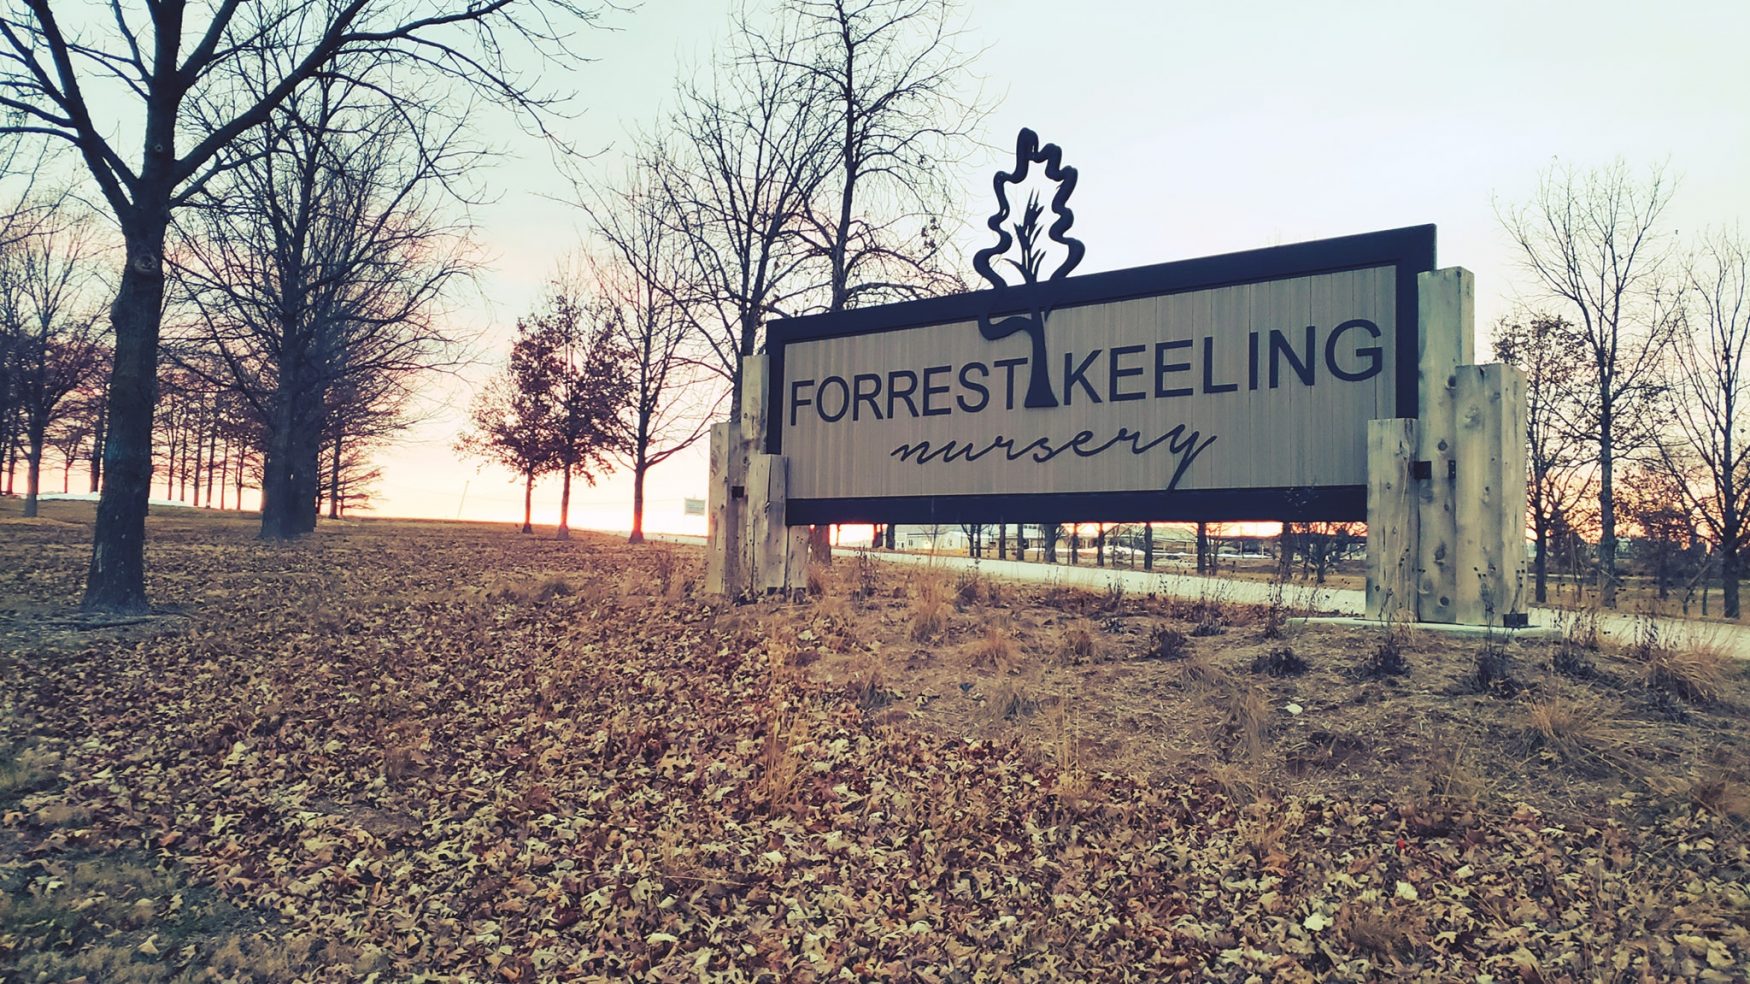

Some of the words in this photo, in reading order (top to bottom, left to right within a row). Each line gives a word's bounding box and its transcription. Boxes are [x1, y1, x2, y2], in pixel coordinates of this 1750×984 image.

[791, 358, 1028, 426] FORREST
[1064, 319, 1383, 406] KEELING
[891, 423, 1217, 491] nursery
